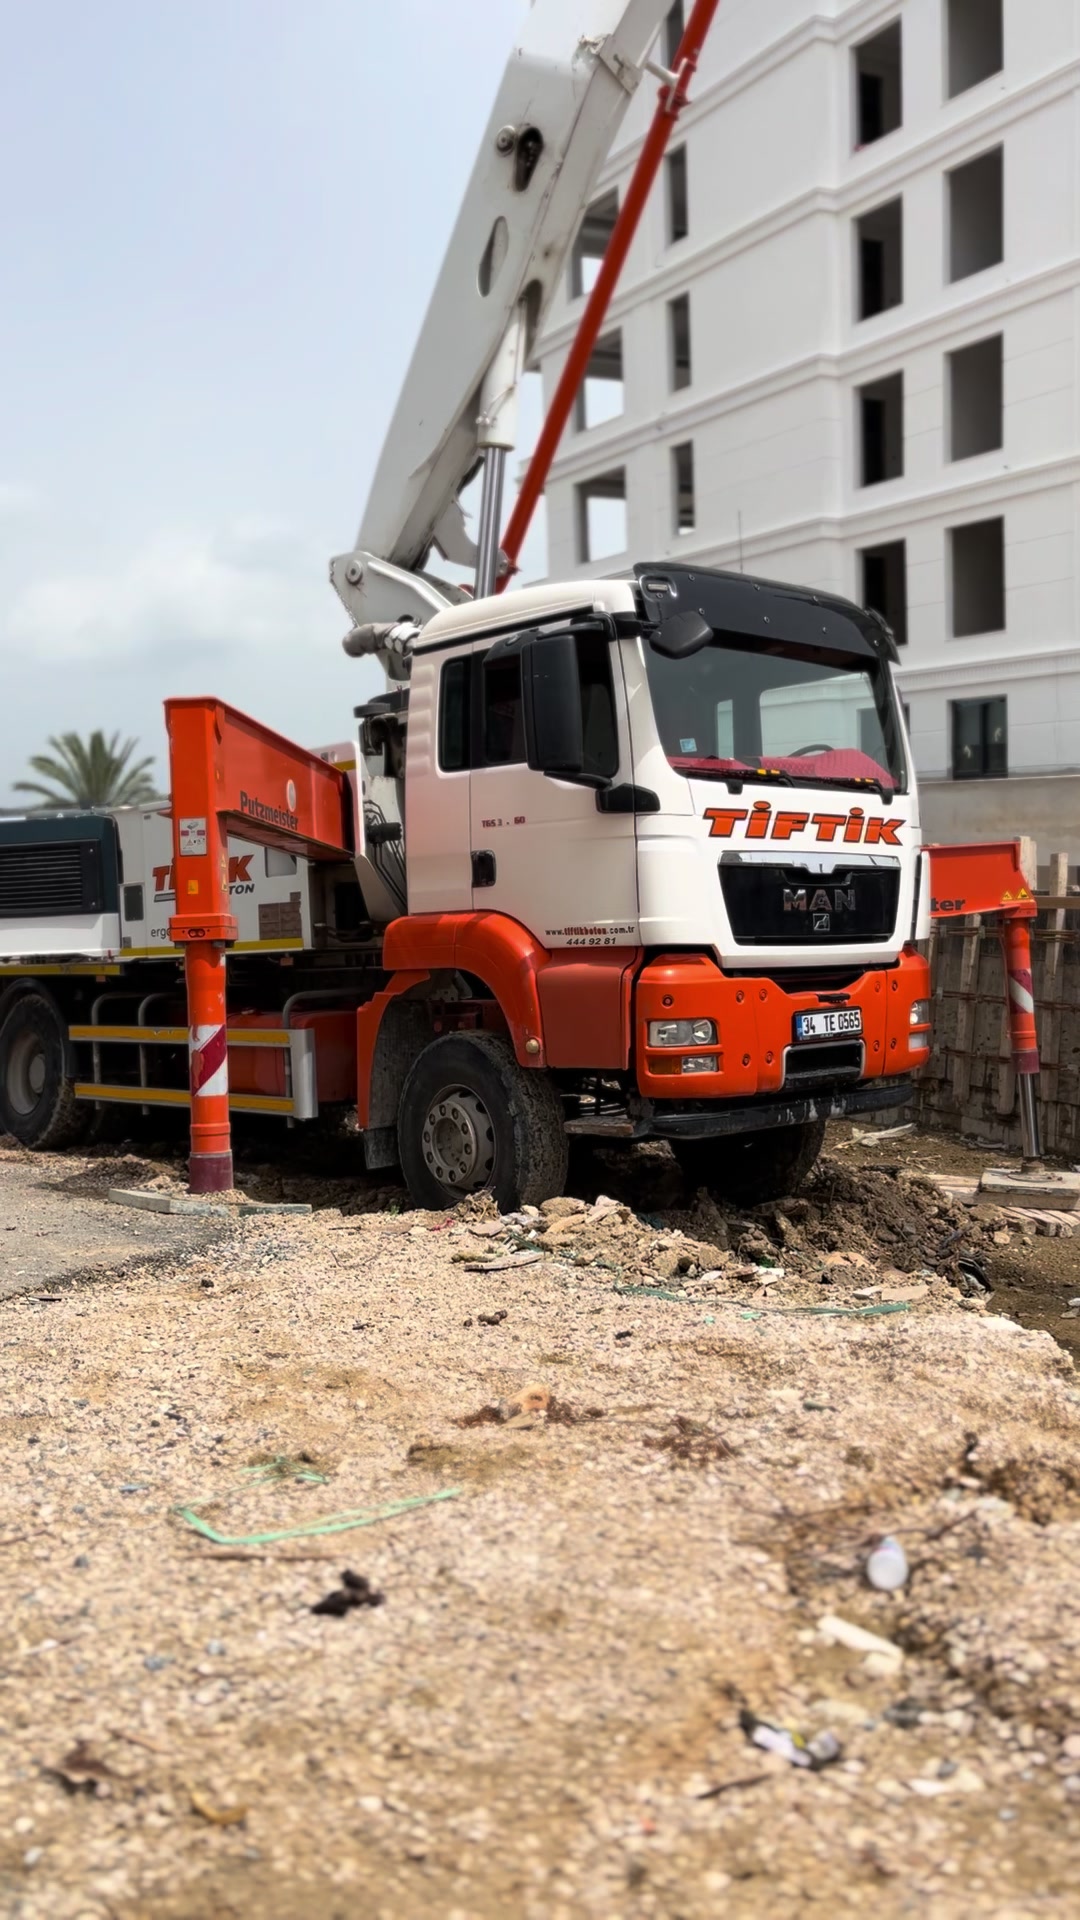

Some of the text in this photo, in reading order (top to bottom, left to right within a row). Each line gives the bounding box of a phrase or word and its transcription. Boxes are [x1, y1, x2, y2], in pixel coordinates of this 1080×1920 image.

[240, 790, 298, 831] Putzmeister
[783, 889, 856, 911] MAN
[588, 937, 601, 945] 92
[604, 937, 616, 945] 81
[803, 1011, 860, 1034] 34 TE 0565
